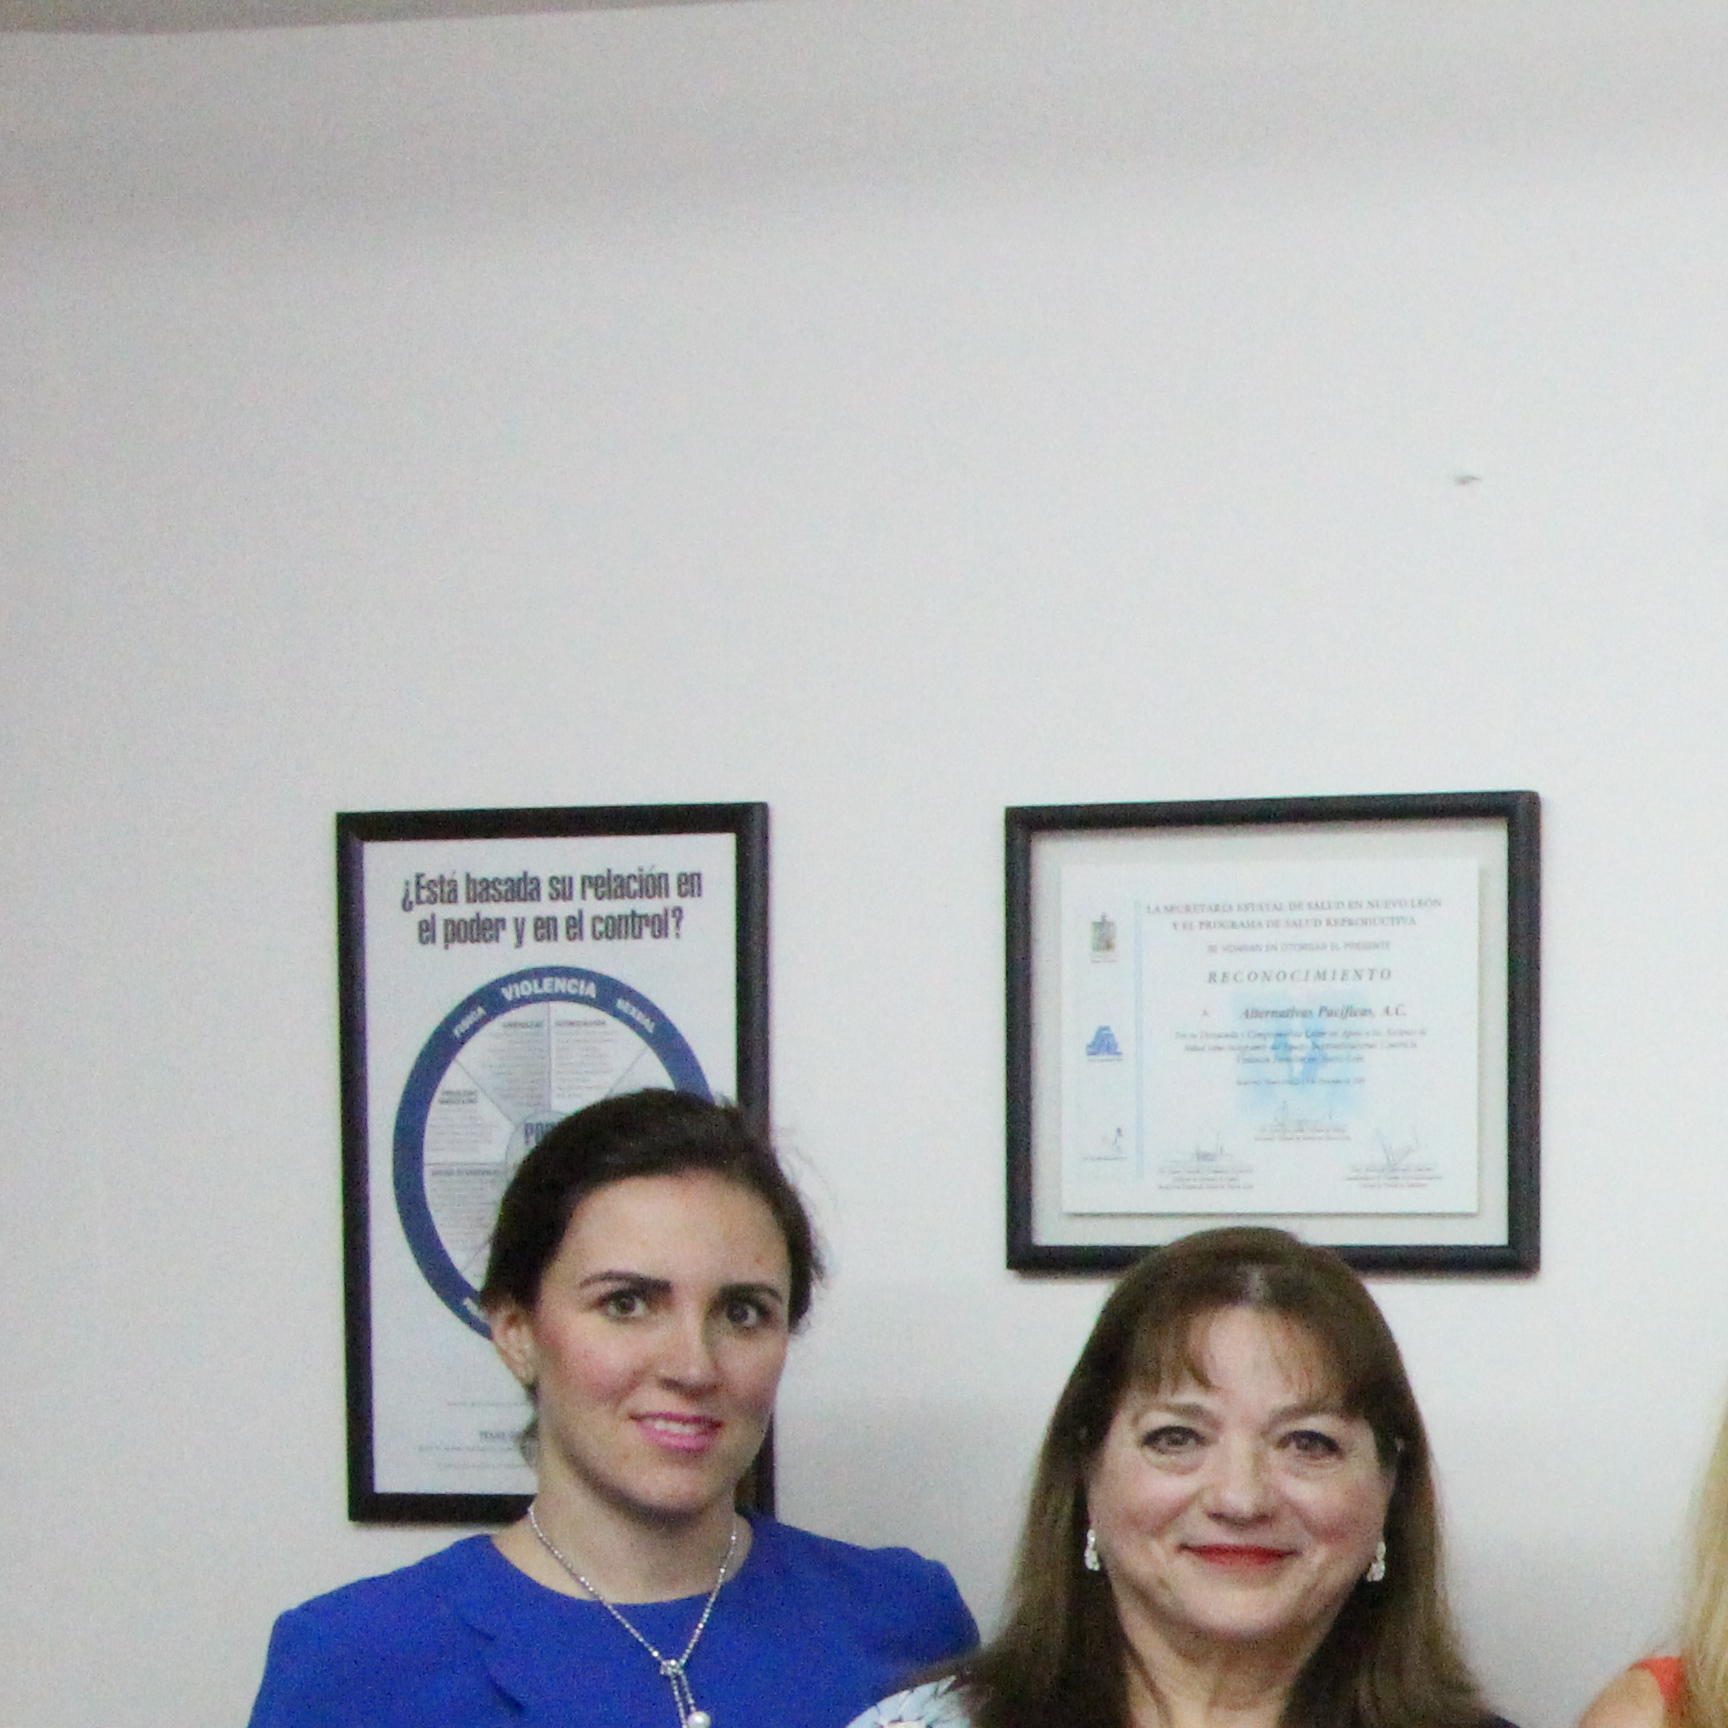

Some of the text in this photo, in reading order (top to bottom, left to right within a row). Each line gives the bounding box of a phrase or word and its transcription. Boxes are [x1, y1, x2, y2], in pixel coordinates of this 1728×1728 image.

[401, 866, 702, 913] ¿Está basada su relación en
[418, 906, 684, 950] el poder y en el control?
[501, 976, 597, 1001] VIOLENCIA
[1207, 967, 1392, 985] RECONOCIMIENTO
